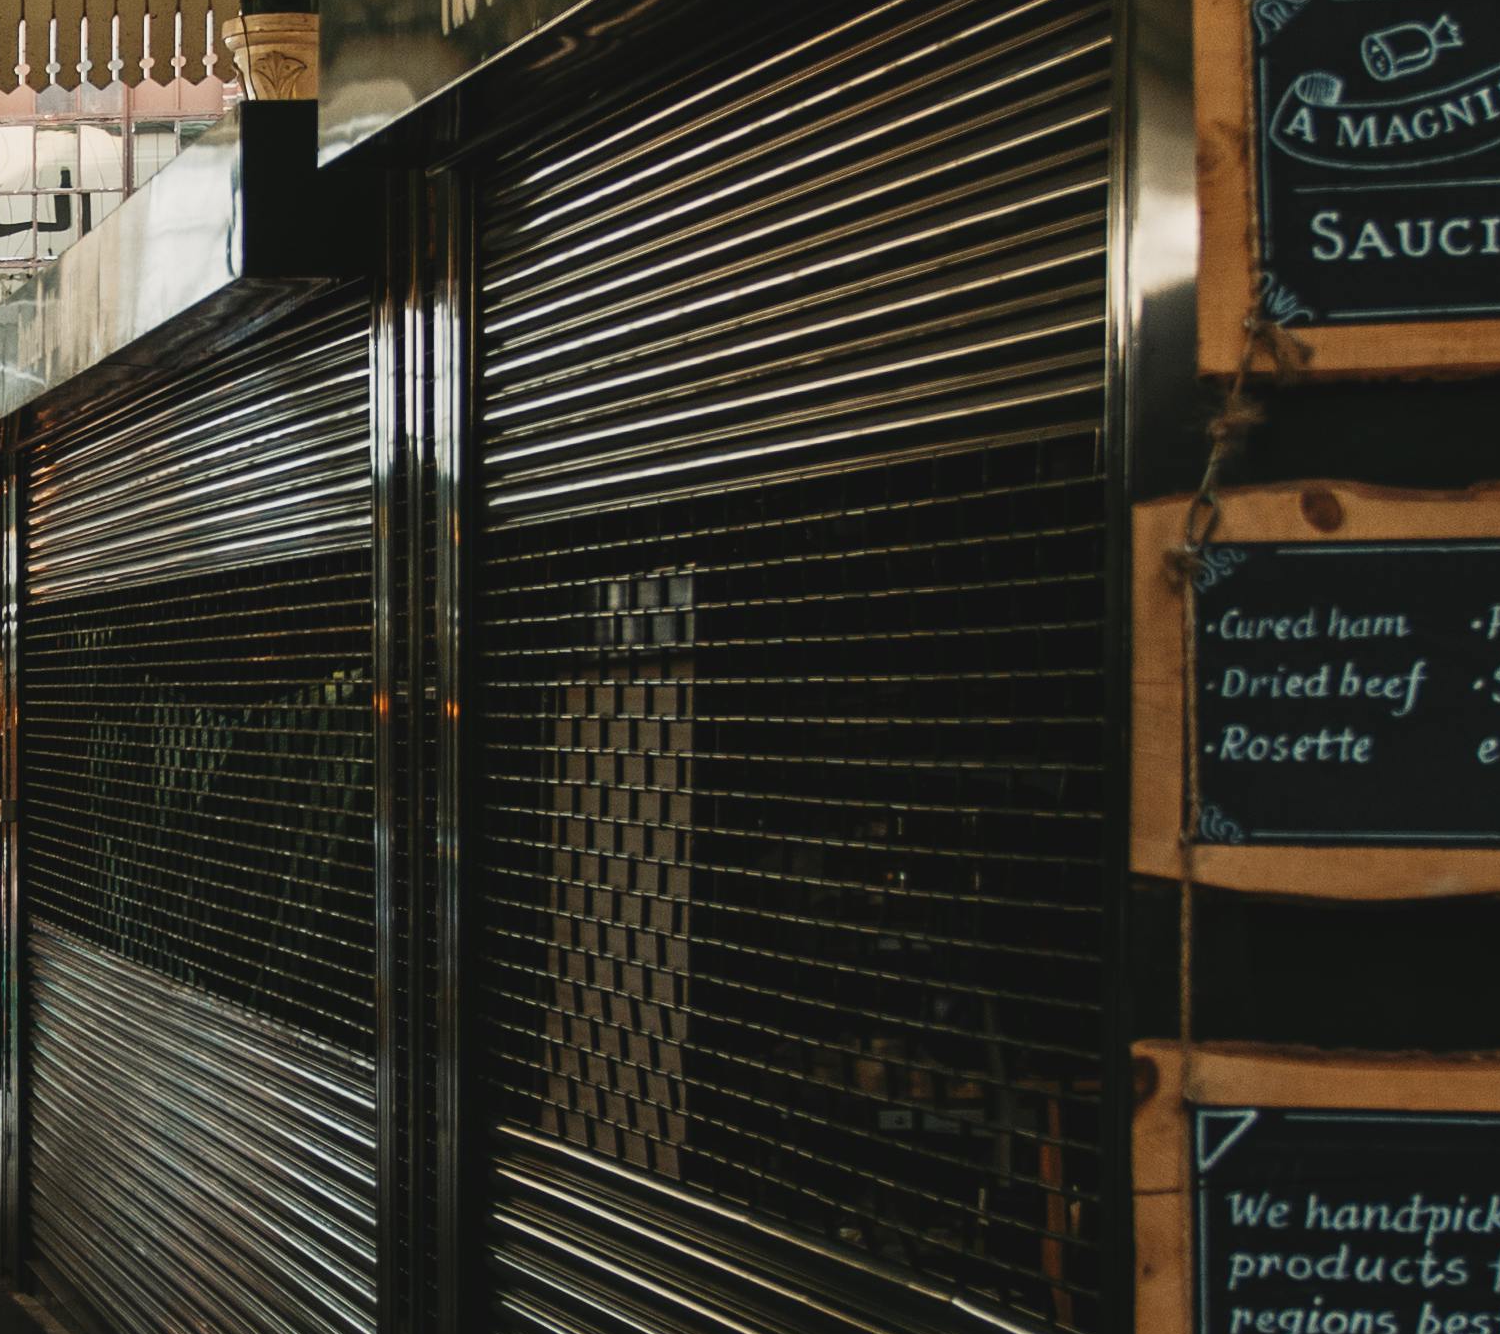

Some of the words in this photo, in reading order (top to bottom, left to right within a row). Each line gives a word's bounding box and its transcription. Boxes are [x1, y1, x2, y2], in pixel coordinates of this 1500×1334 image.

[1283, 112, 1315, 142] A
[1220, 608, 1316, 642] Cured
[1328, 608, 1410, 640] ham
[1220, 665, 1331, 699] Dried
[1339, 661, 1429, 716] beef
[1219, 725, 1374, 763] Rosette
[1228, 1192, 1290, 1230] We
[1228, 1246, 1468, 1291] products
